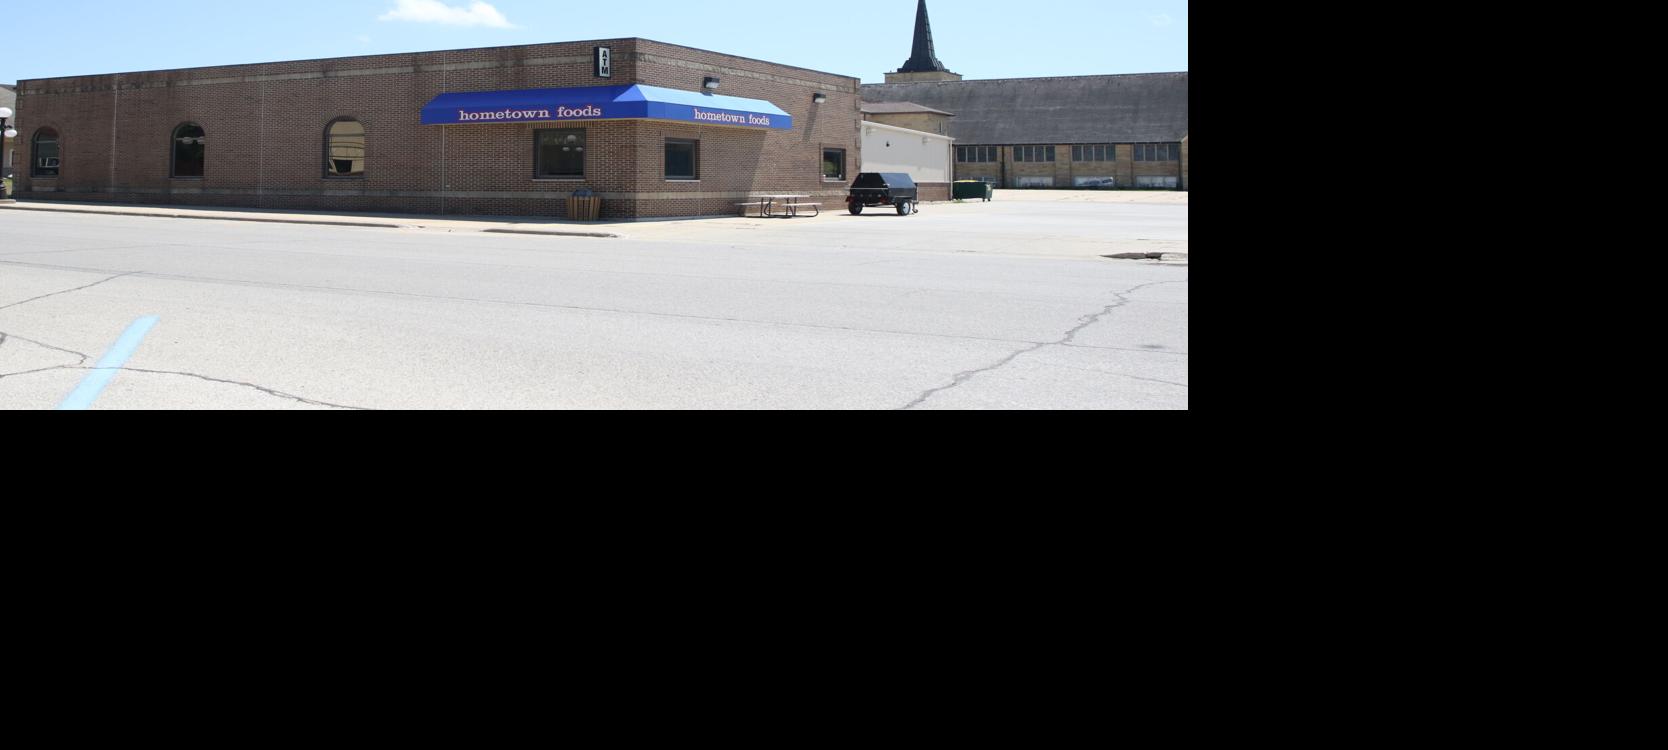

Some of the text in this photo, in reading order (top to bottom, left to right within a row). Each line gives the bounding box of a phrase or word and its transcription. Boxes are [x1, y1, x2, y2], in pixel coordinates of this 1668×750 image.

[459, 105, 602, 121] hometown foods
[694, 108, 770, 126] hometown foods
